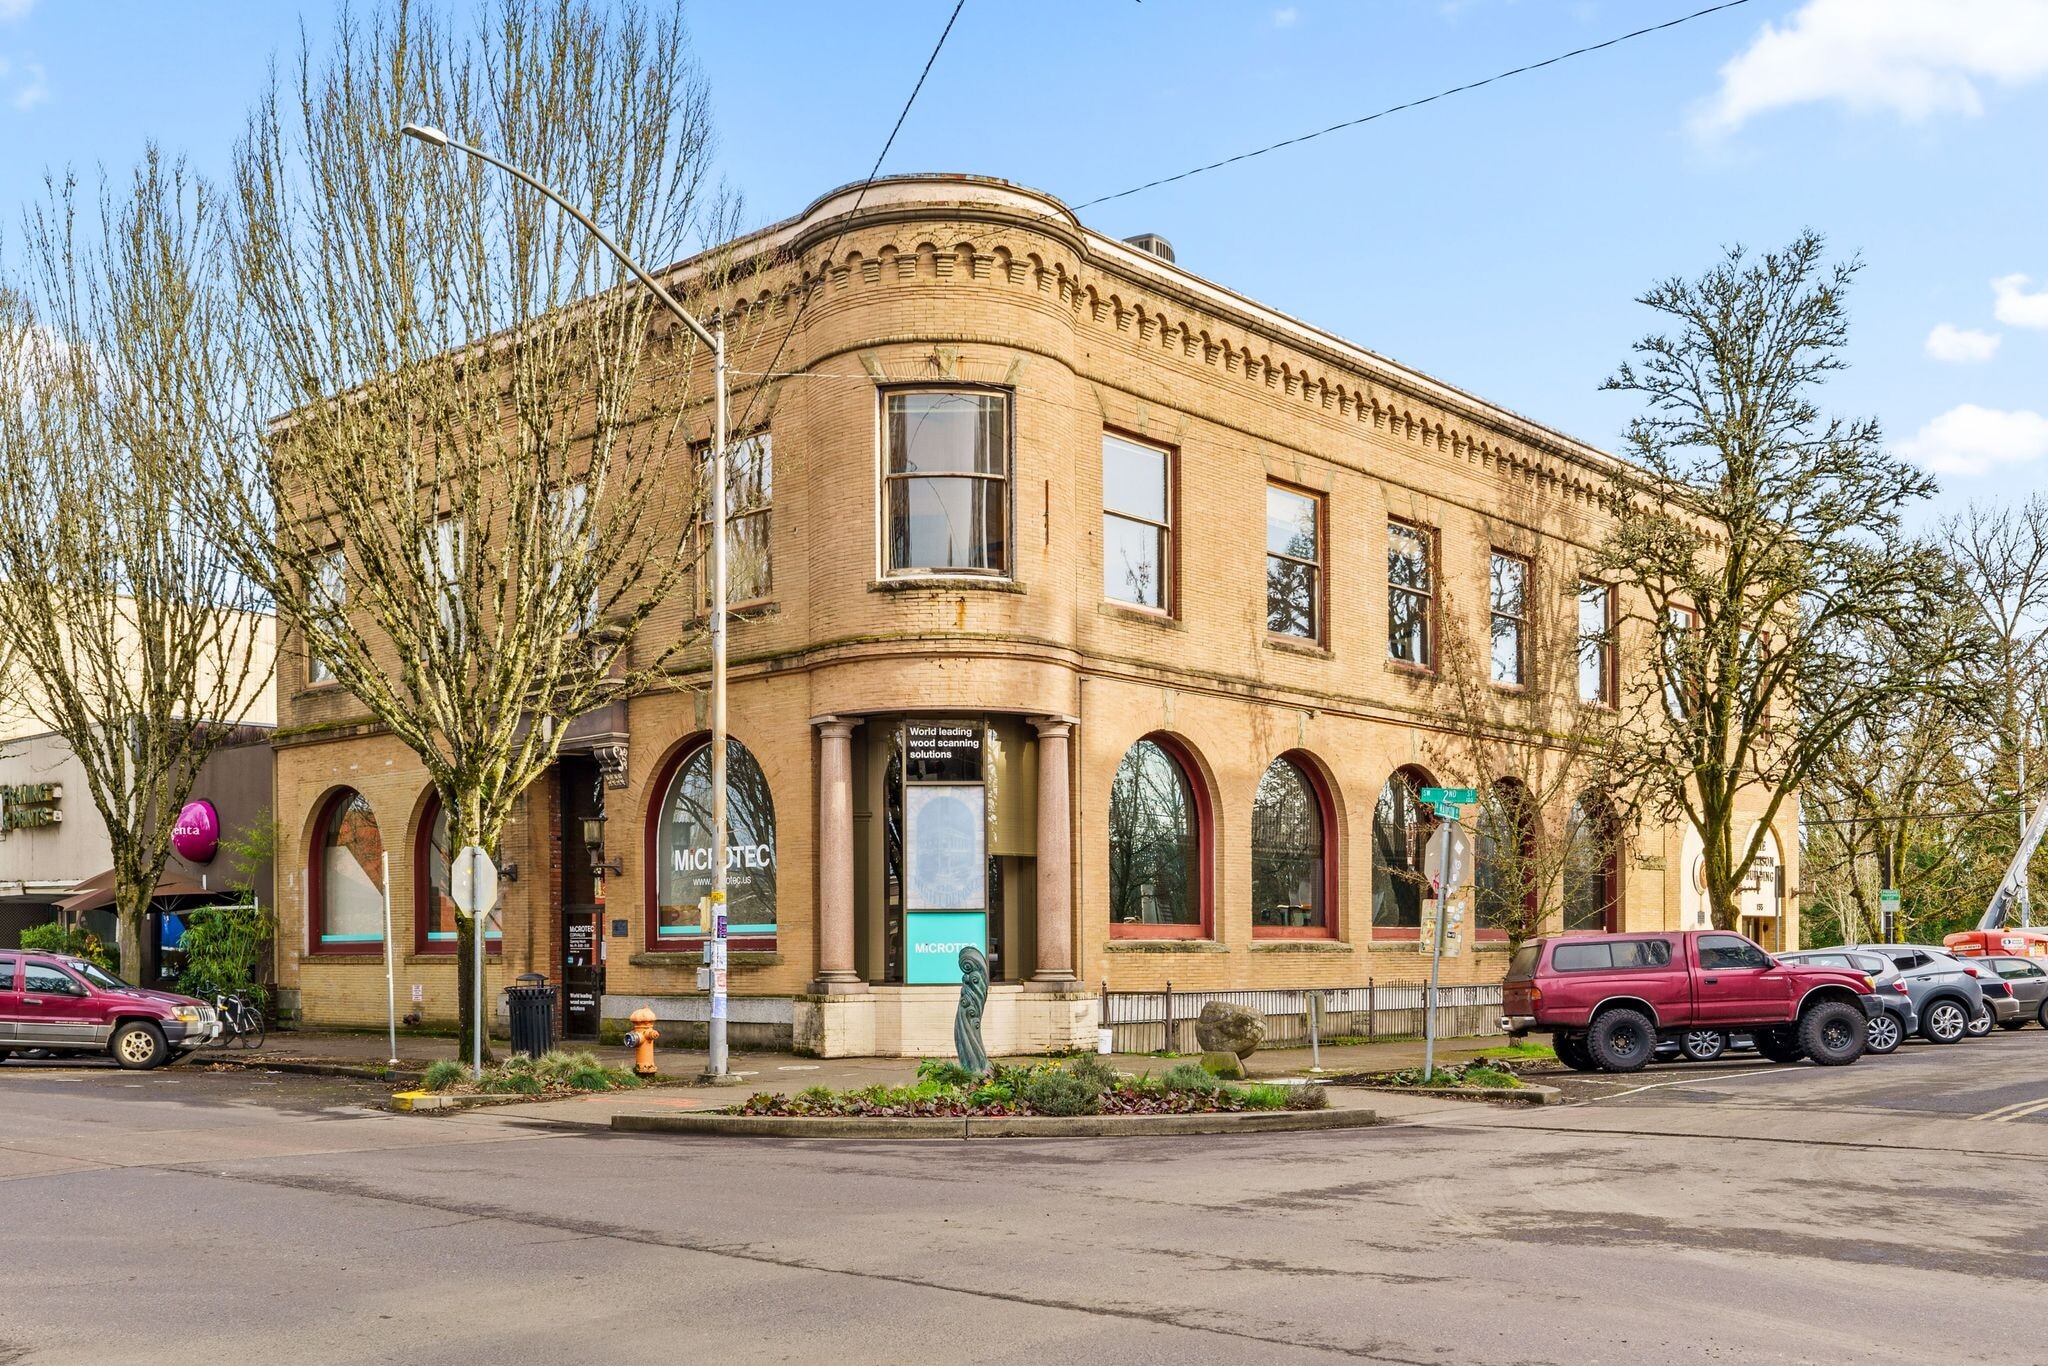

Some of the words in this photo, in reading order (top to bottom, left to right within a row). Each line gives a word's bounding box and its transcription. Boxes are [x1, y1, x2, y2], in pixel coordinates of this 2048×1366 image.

[909, 727, 937, 736] World
[938, 727, 973, 738] leading
[909, 738, 936, 747] wood
[937, 738, 979, 749] scanning
[909, 749, 952, 759] solutions
[1442, 790, 1457, 802] 2ND
[12, 807, 48, 829] PRINTS
[173, 825, 200, 837] enta
[693, 876, 752, 886] www.otec.us
